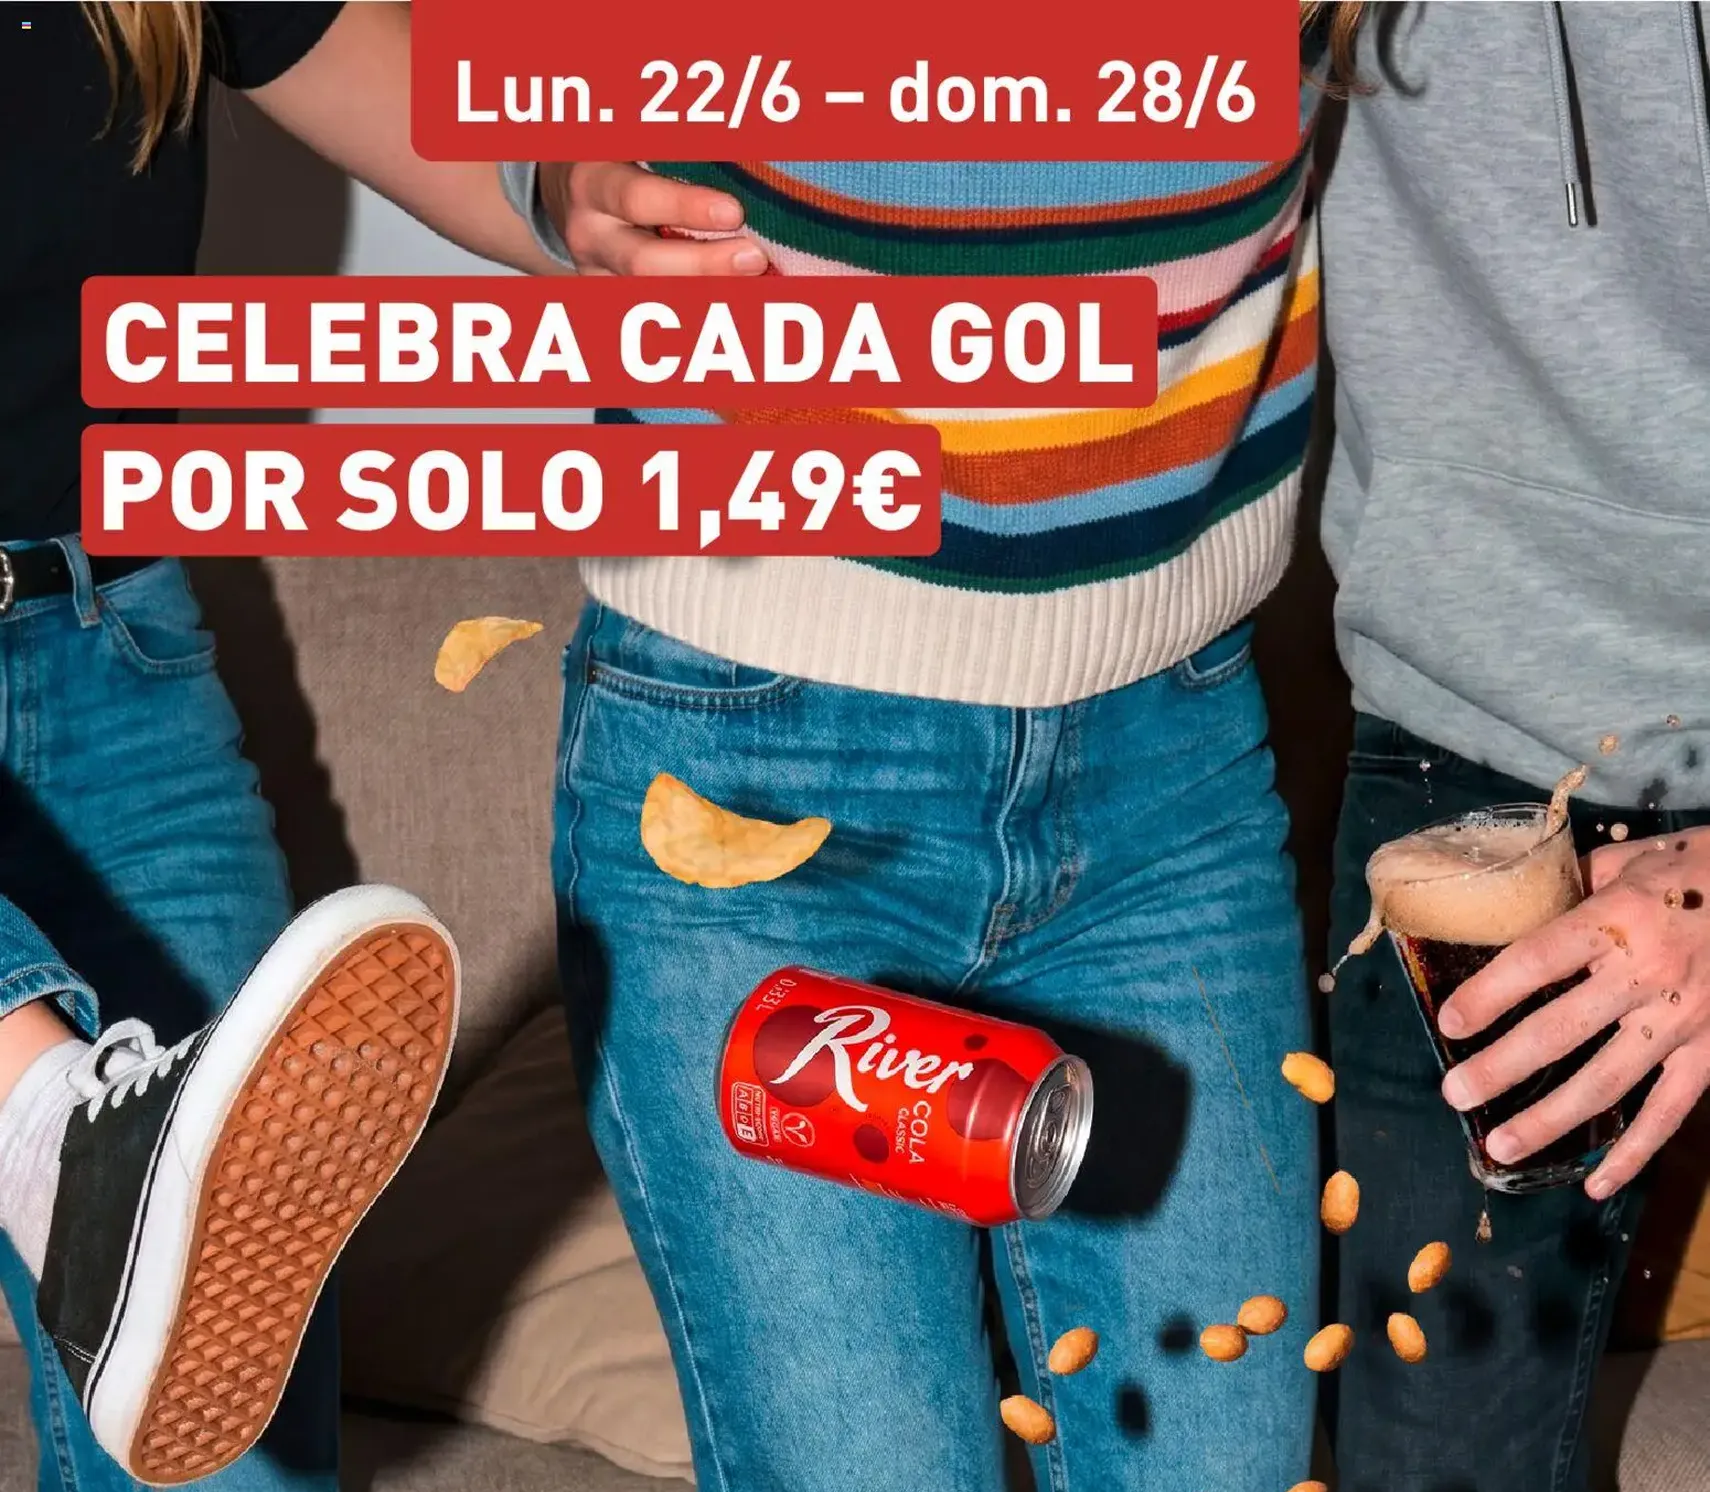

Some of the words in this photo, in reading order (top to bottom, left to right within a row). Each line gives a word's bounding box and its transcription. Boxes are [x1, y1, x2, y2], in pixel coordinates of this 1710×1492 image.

[770, 1005, 973, 1112] River
[895, 1107, 908, 1154] CLASSIC
[908, 1100, 932, 1165] COLA
